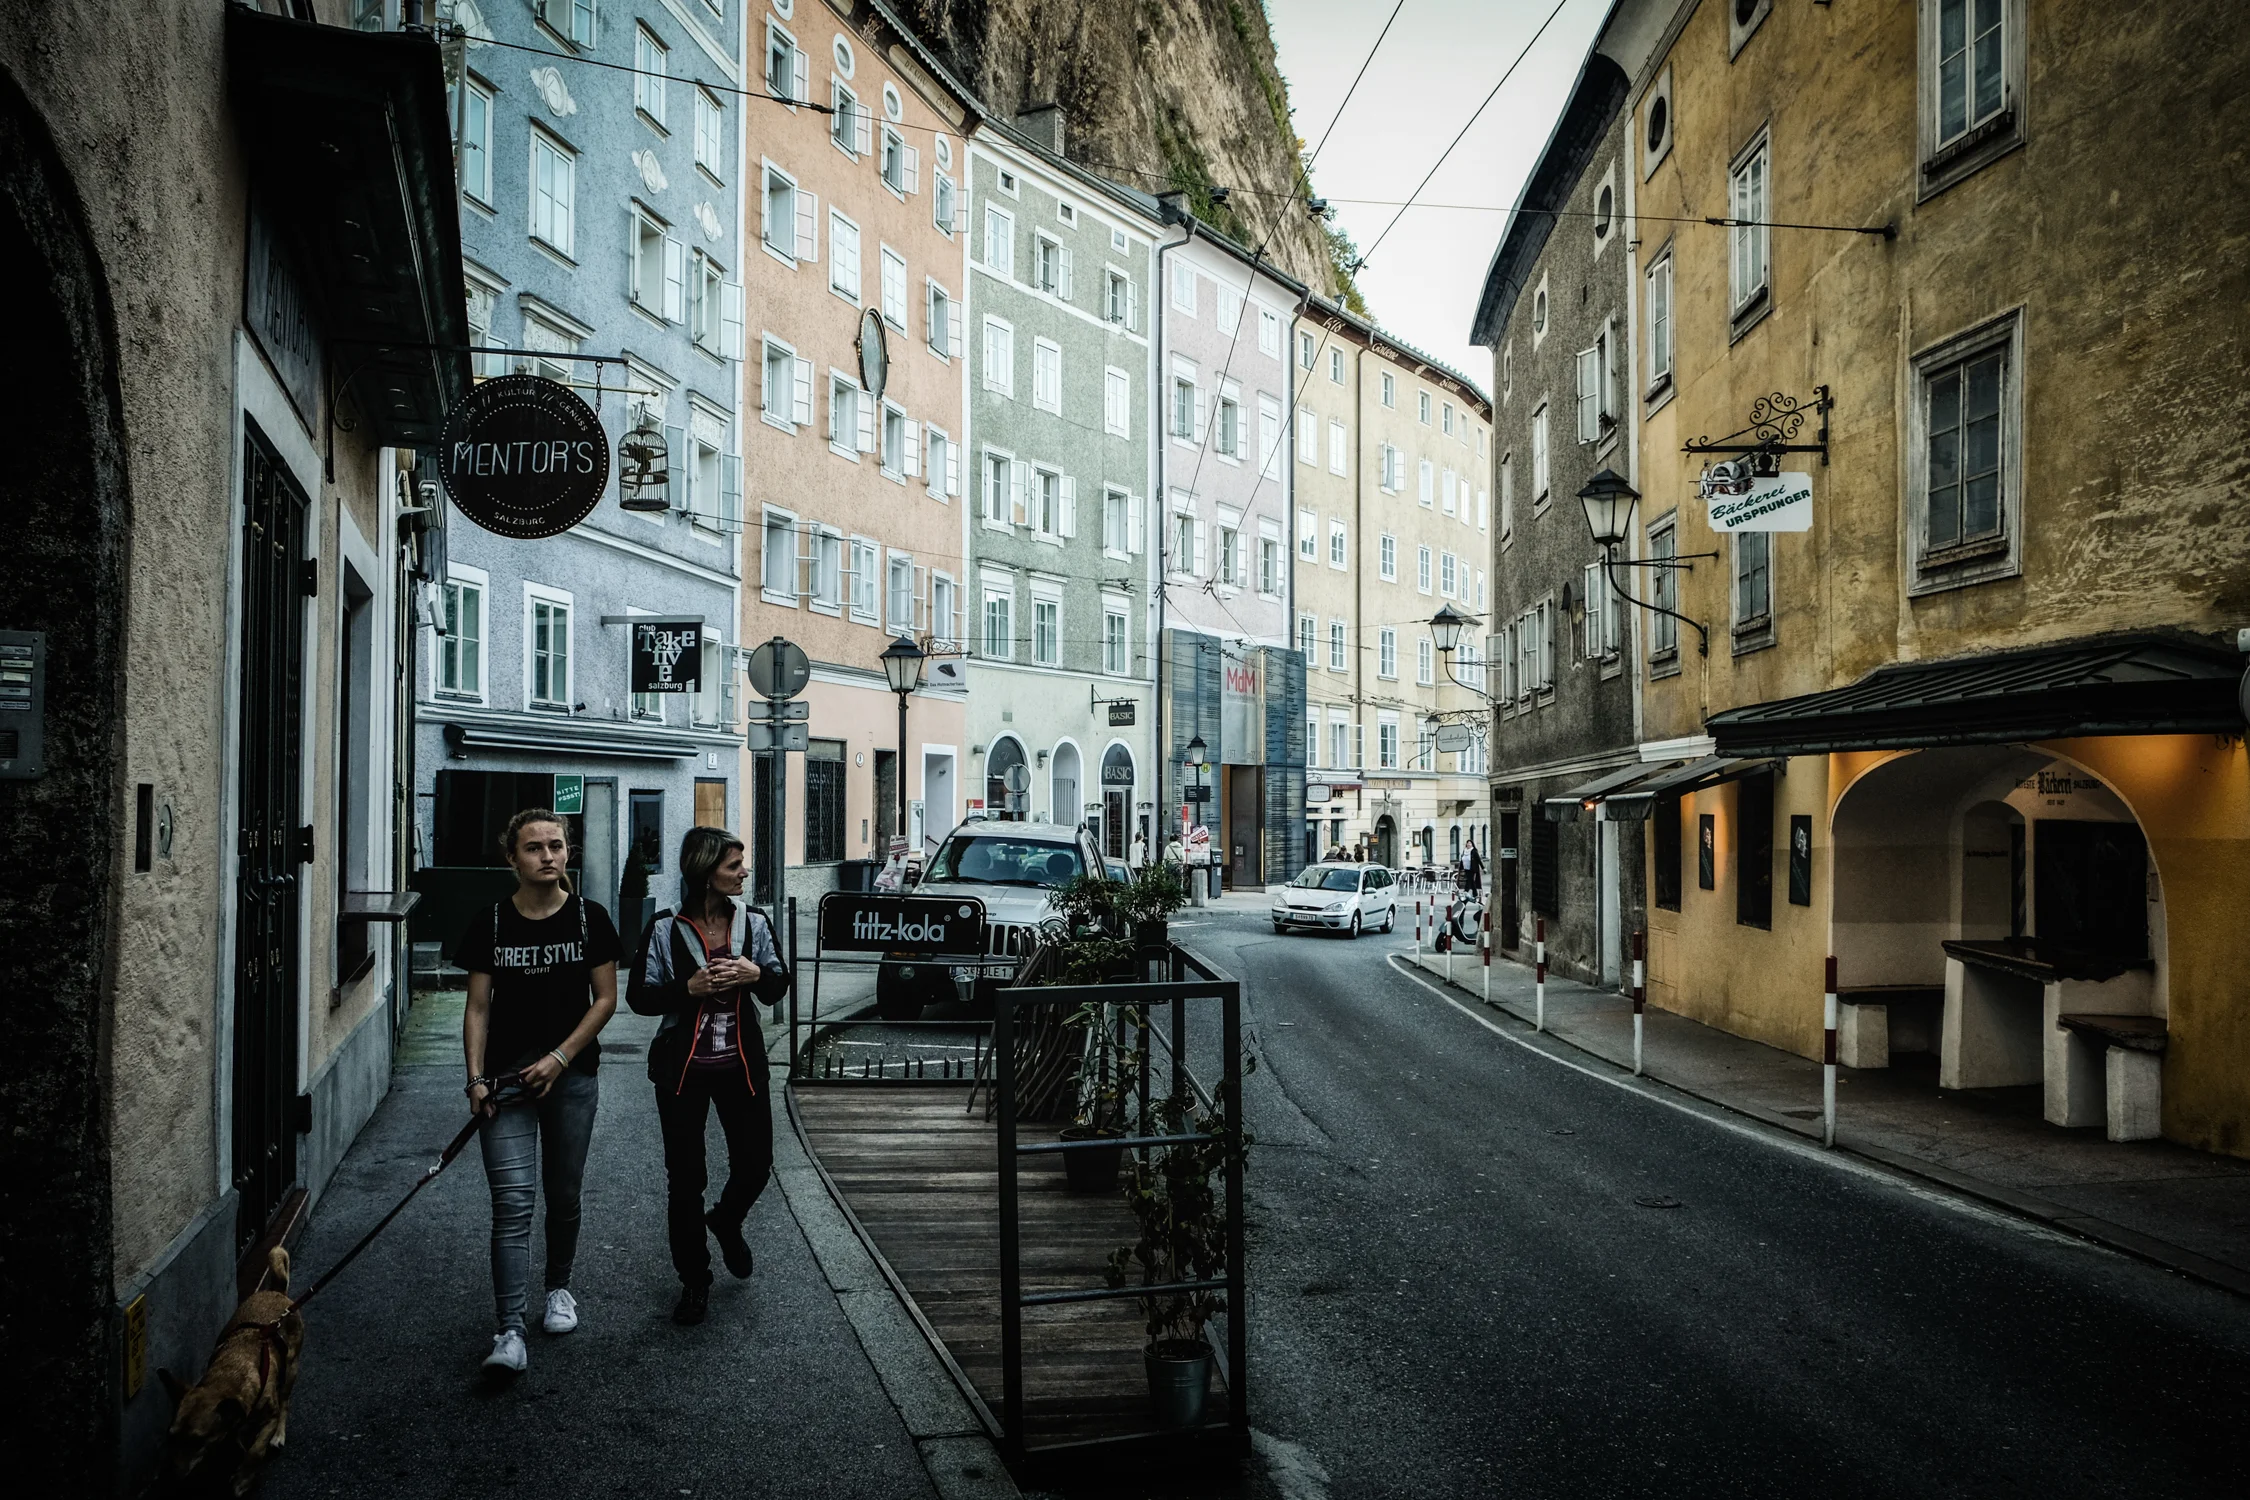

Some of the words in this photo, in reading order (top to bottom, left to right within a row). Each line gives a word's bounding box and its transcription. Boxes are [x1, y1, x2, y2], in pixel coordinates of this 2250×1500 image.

[497, 388, 536, 398] KULTUR
[559, 401, 588, 431] GENUSS
[452, 440, 593, 476] MENTOR'S
[1710, 484, 1786, 520] Bäckerei
[1725, 489, 1811, 527] URSPRUNGER
[494, 511, 545, 525] SALZBURG
[638, 630, 696, 652] Take
[648, 682, 682, 691] salzburg
[1226, 666, 1256, 694] MdM
[1109, 712, 1134, 720] BASIC
[1104, 765, 1132, 780] BASIC
[556, 785, 579, 796] BITTE
[852, 910, 945, 942] fritz-kola
[494, 946, 540, 967] STREET
[543, 941, 584, 965] STYLE
[524, 966, 550, 975] OUTFIT
